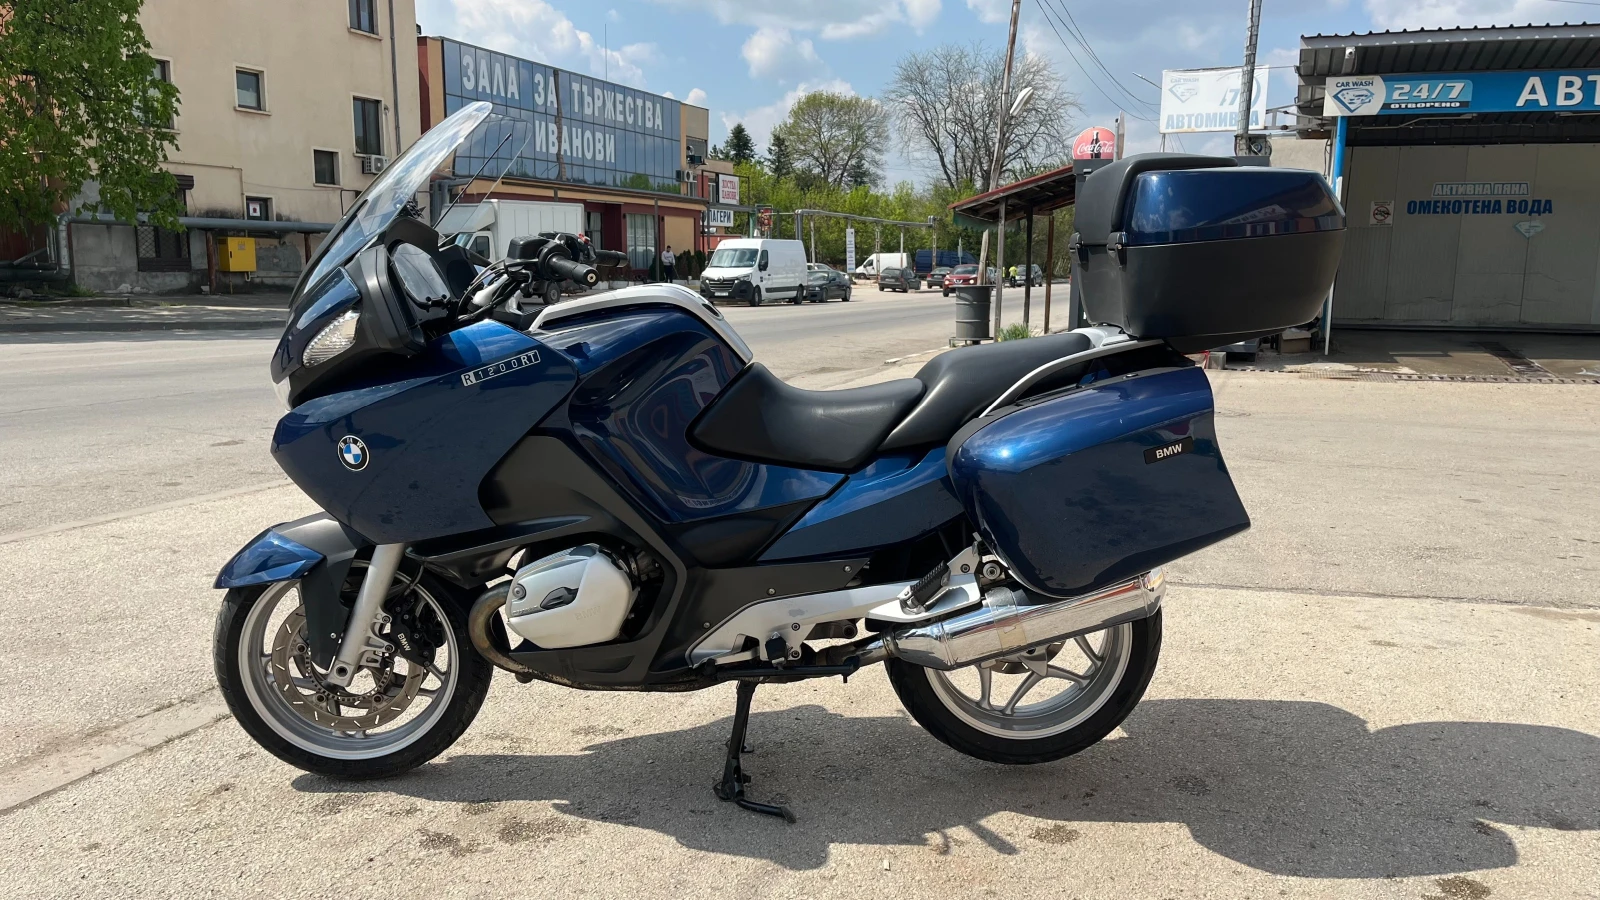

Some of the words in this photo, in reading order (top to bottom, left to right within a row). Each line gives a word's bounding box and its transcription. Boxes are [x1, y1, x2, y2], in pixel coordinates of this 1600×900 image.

[462, 54, 519, 100] ЗАЛА
[534, 72, 557, 108] ЗА
[571, 82, 663, 131] ТЪРЖЕСТВА
[1392, 82, 1466, 100] 24/7
[1165, 110, 1259, 130] АВТОМИВА
[535, 120, 615, 163] ИВАНОВИ
[1434, 184, 1491, 195] АКТИВНА
[1493, 183, 1528, 195] ПЯНА
[1406, 200, 1502, 215] ОМЕКОТЕНА
[1506, 199, 1553, 216] ВОДА
[1155, 443, 1182, 459] BMW
[397, 632, 411, 651] BMW
